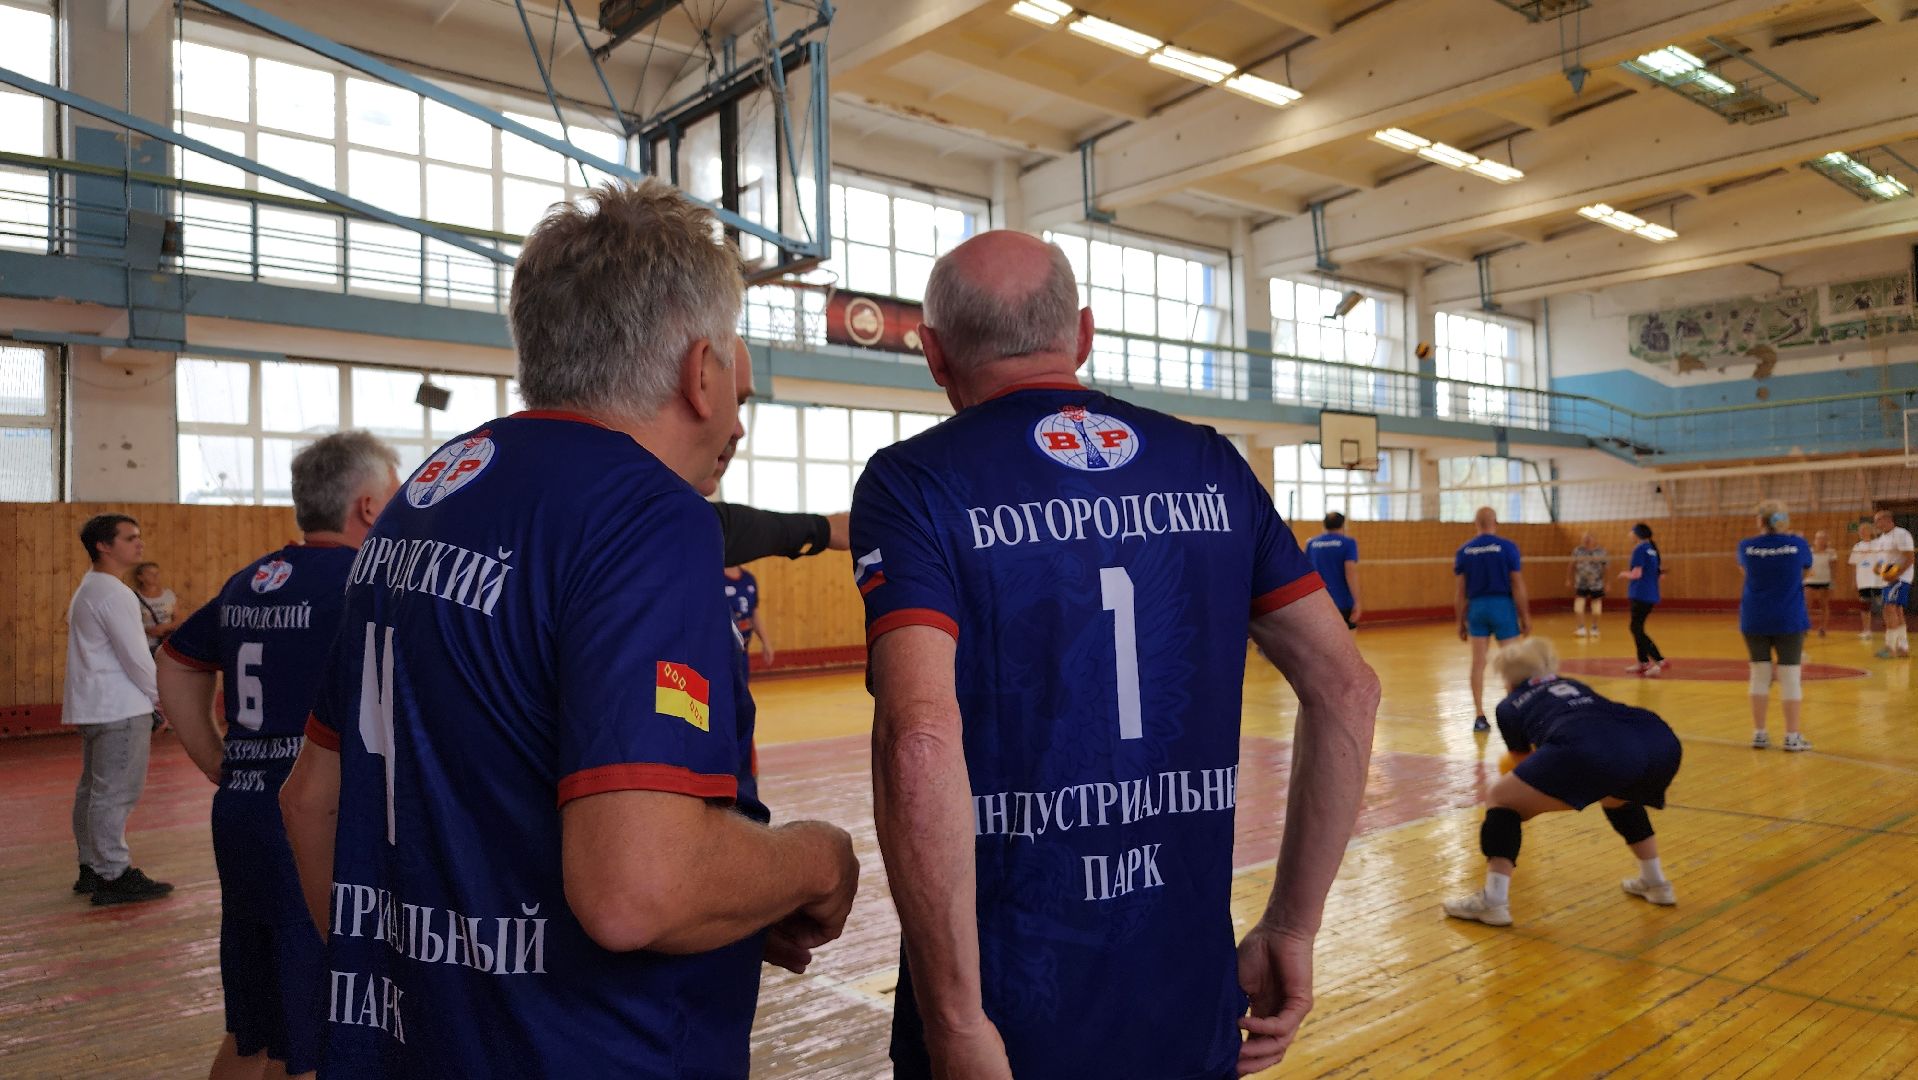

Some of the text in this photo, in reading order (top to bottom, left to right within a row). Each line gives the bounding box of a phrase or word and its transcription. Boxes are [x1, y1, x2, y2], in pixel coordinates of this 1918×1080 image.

[966, 483, 1232, 549] БОГОРОДСКИЙ
[344, 535, 514, 617] ОРОДСКИЙ
[237, 641, 264, 731] 6
[1099, 566, 1143, 740] 1
[358, 621, 396, 846] 4
[1081, 843, 1166, 901] ПАРК
[332, 882, 549, 975] ТРИАЛЬНЫЙ
[328, 970, 406, 1045] ПАРК
